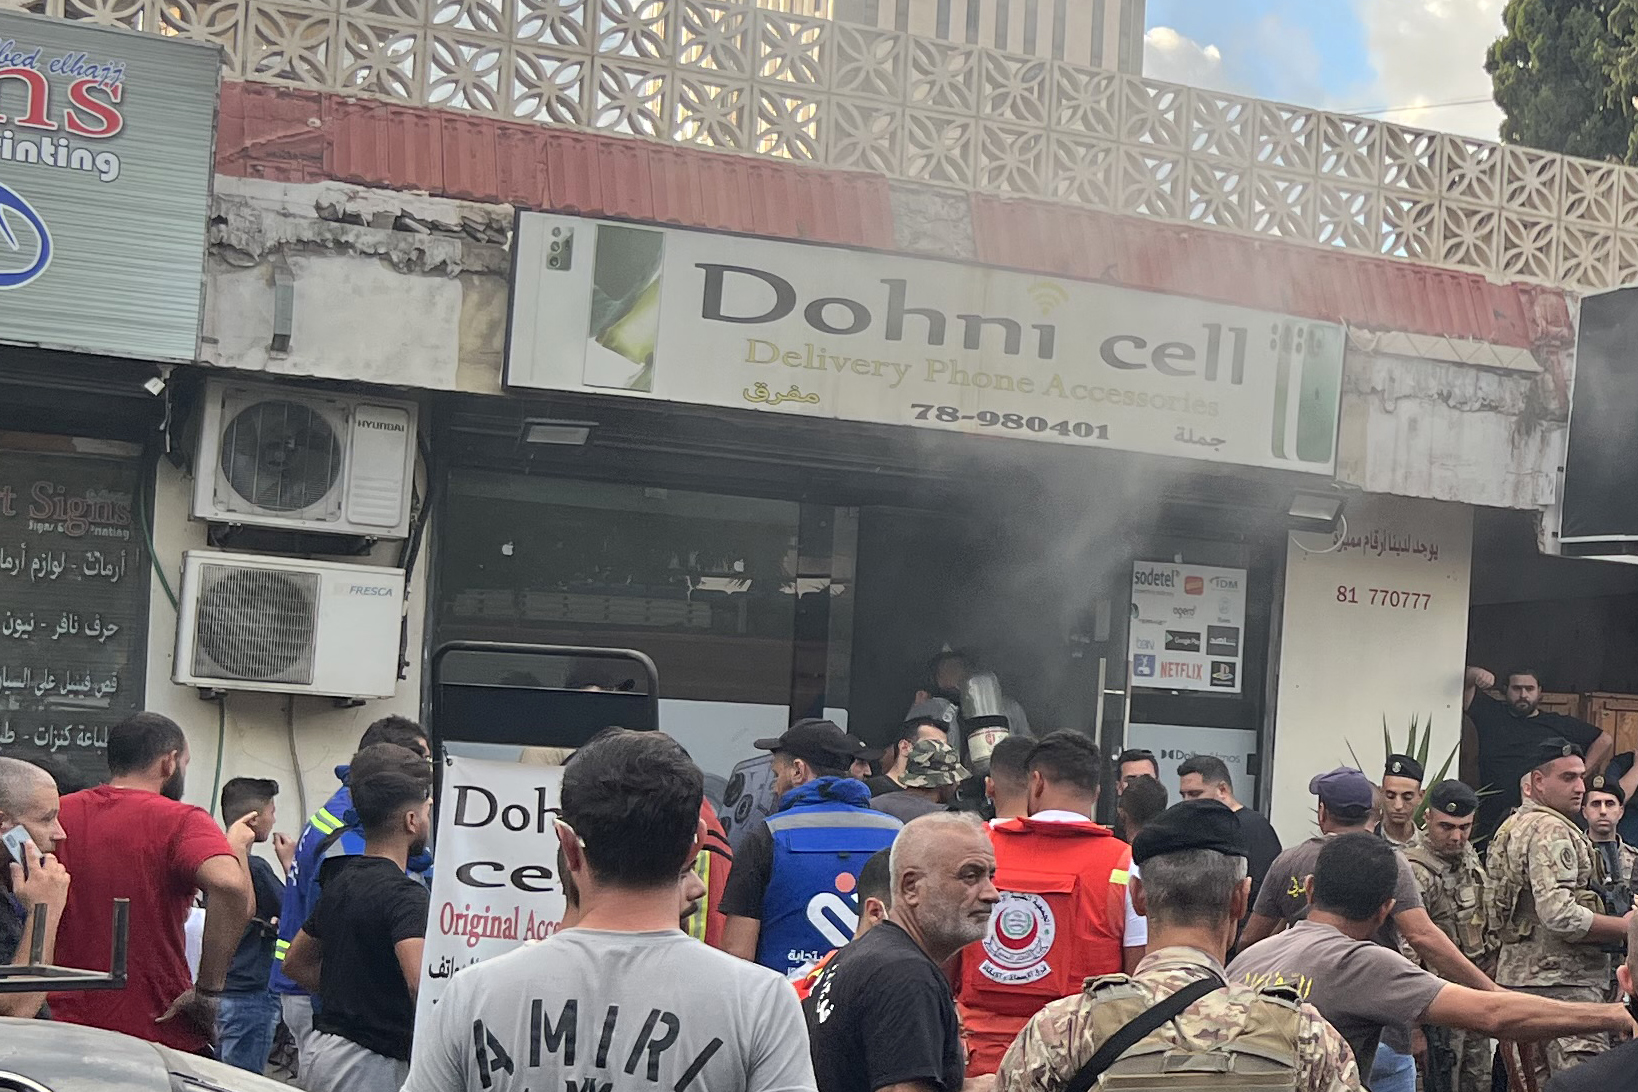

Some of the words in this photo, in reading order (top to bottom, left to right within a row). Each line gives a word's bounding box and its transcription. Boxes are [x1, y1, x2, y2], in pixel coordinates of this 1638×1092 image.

[0, 40, 42, 69] bed
[50, 52, 126, 88] elhajj
[0, 68, 124, 138] ns
[0, 129, 121, 183] inting
[695, 262, 1056, 360] Dohni
[1099, 322, 1248, 386] cell
[744, 338, 912, 389] Delivery
[924, 358, 1035, 393] Phone
[1041, 373, 1220, 417] Accessories
[742, 382, 821, 406] مفرق
[357, 419, 405, 432] HYUNDAI
[910, 402, 1110, 441] 78-980401
[1174, 426, 1227, 452] جملة
[28, 480, 132, 538] Signs
[0, 541, 26, 576] أرما
[349, 585, 394, 598] FRESCA
[1134, 568, 1176, 588] sodetel
[1336, 585, 1359, 604] 81
[1368, 588, 1432, 611] 770777
[2, 610, 35, 639] نيون
[51, 611, 79, 640] نافر
[84, 613, 120, 644] حرف
[0, 665, 32, 695] السيا
[34, 667, 56, 697] على
[1160, 660, 1203, 680] NETFLIX
[453, 785, 562, 833] Doh
[455, 861, 554, 892] ce
[440, 901, 520, 948] Original
[523, 909, 561, 941] Acc
